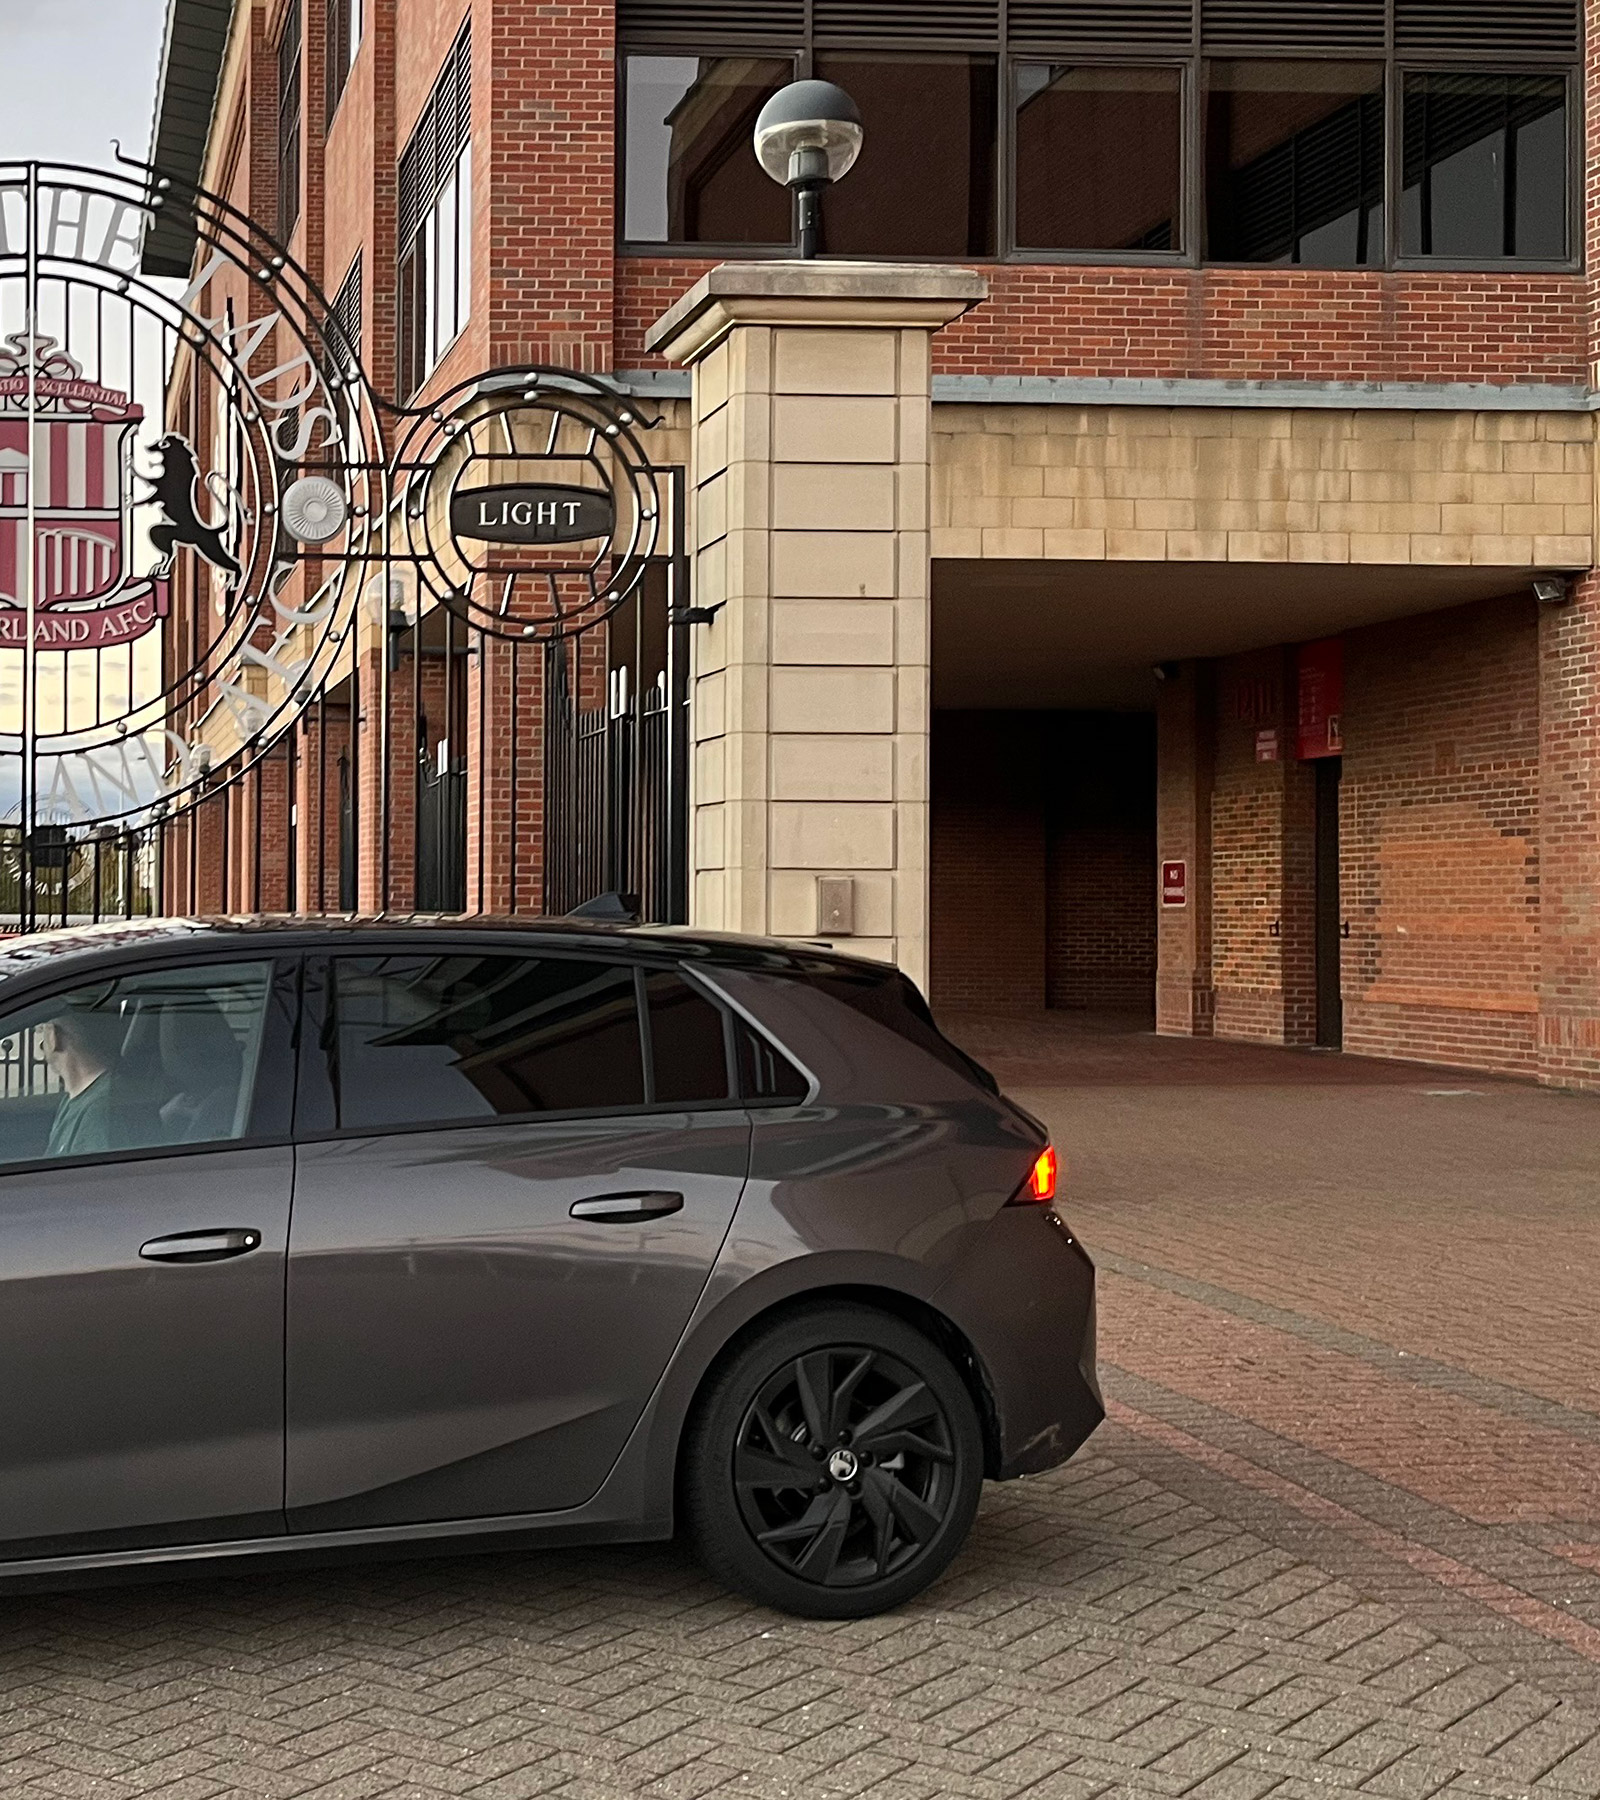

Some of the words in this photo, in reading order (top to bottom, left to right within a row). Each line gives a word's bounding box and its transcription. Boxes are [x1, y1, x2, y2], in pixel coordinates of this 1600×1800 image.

[177, 247, 344, 460] LADS
[478, 501, 582, 526] LIGHT
[213, 560, 338, 744] AFC
